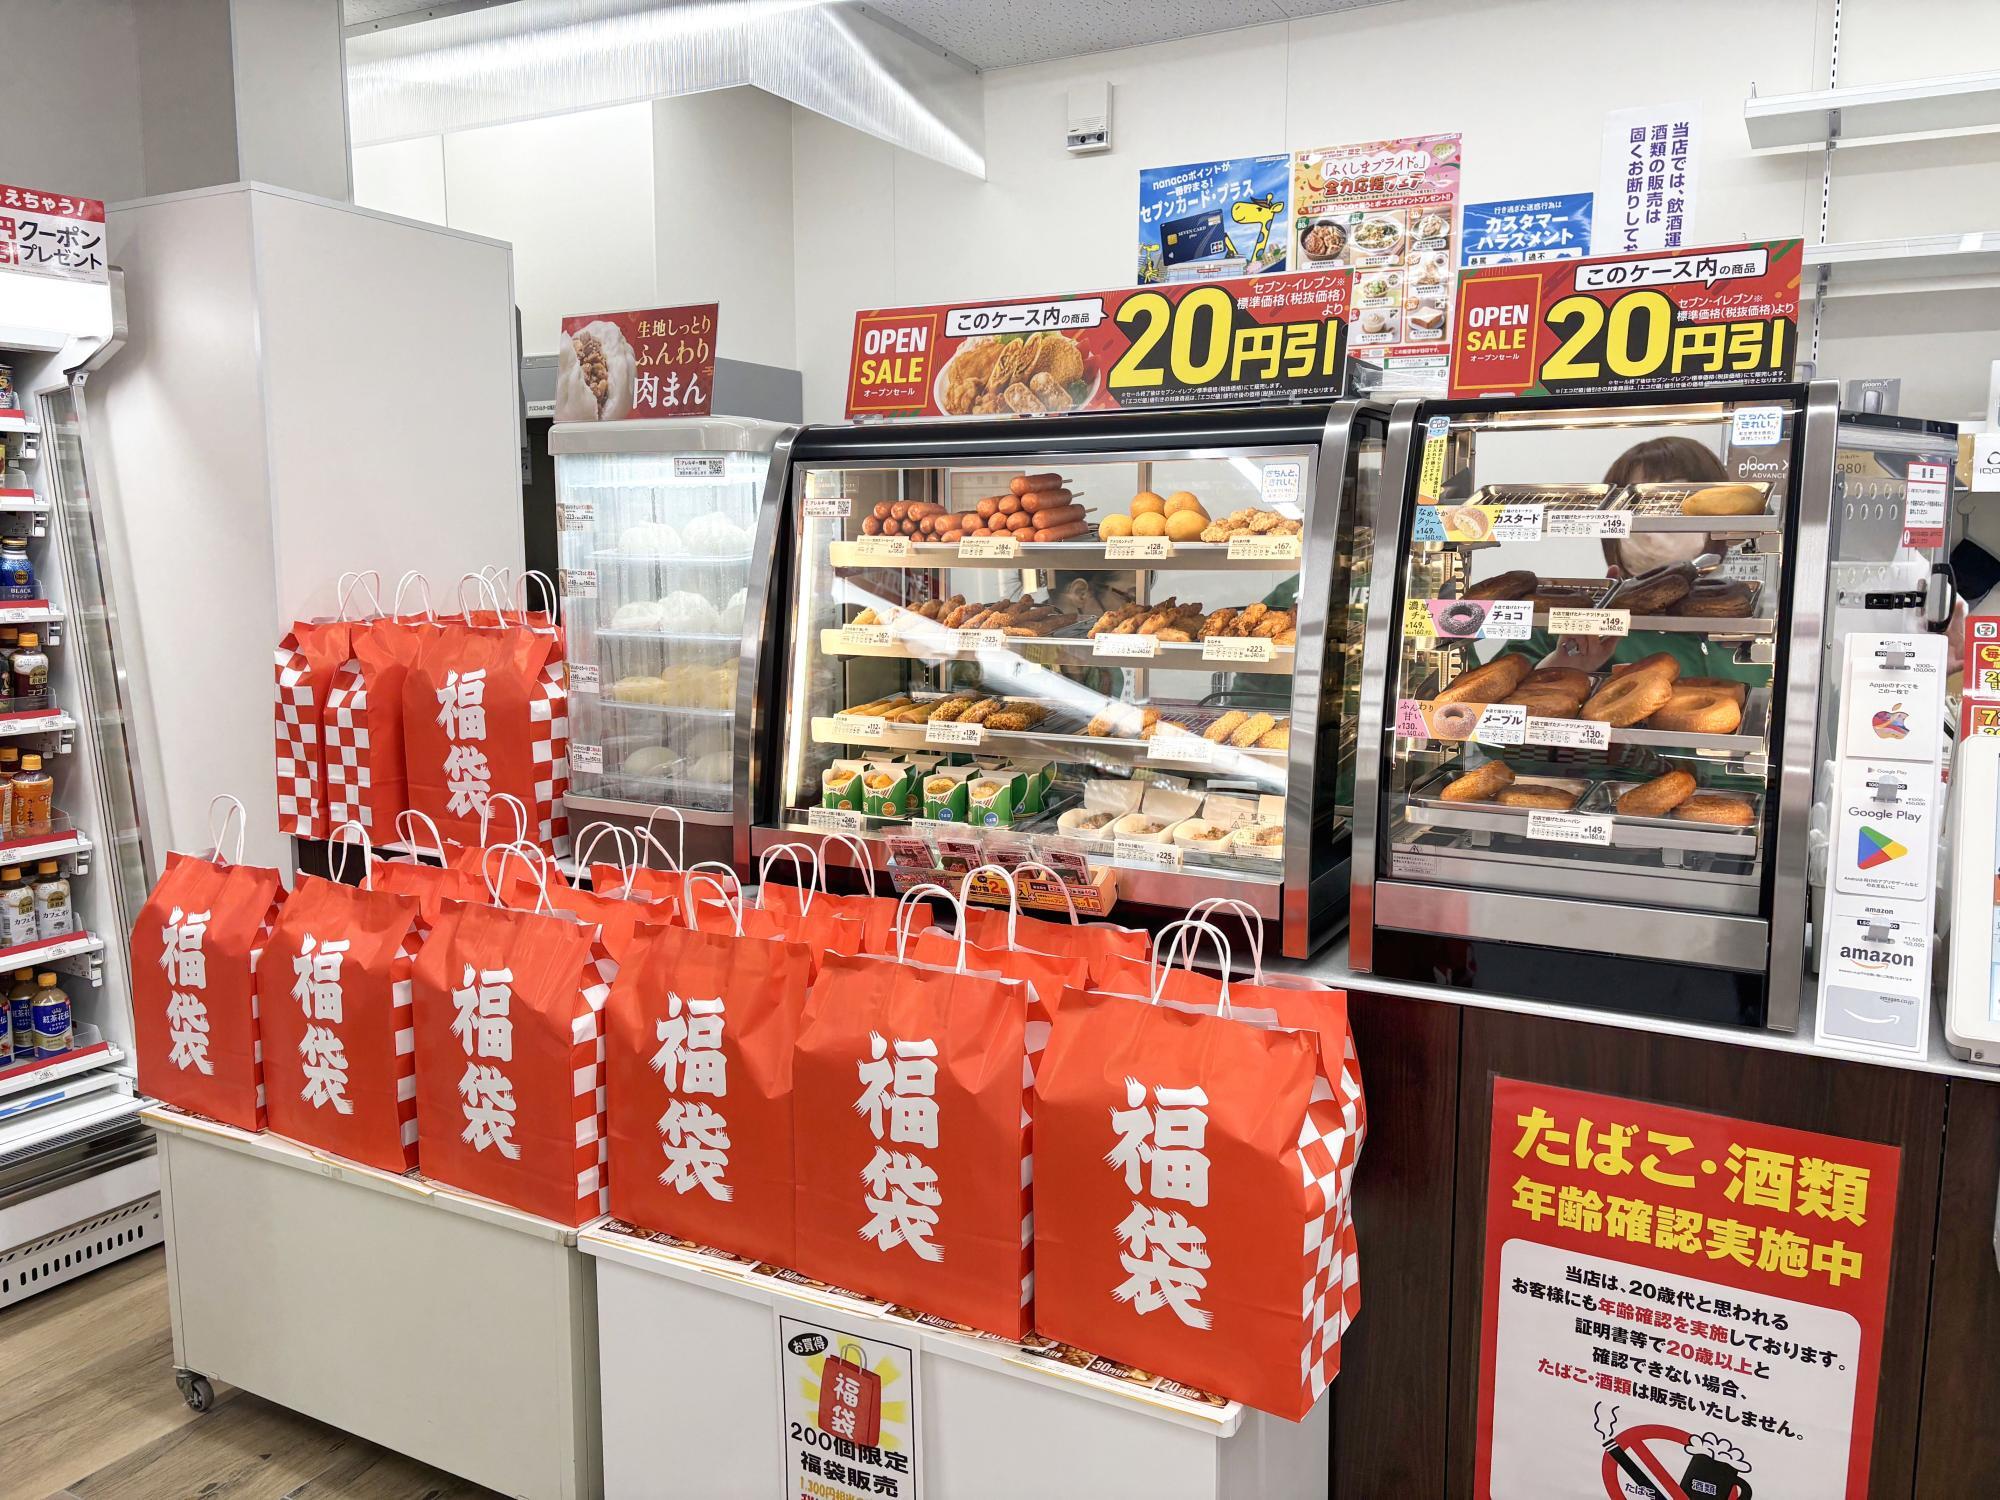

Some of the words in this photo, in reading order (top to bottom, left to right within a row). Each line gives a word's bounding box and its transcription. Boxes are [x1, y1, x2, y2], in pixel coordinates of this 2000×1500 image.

[1153, 161, 1231, 190] nanacoポイントが
[1323, 172, 1426, 196] 全力応援フェア
[1646, 124, 1668, 224] 酒類の販売は
[1665, 122, 1689, 248] 当店では、飲酒運
[0, 188, 86, 217] えちゃう!
[1140, 179, 1255, 224] セブンカード・プラス
[18, 221, 101, 250] クーポン
[1485, 213, 1569, 233] カスタマー
[1477, 228, 1574, 250] ハラスメント
[20, 243, 102, 270] プレゼント
[1587, 257, 1756, 286] このケース内の商品
[1236, 288, 1346, 310] 標準価格(税抜価格)
[1321, 303, 1343, 316] より
[1677, 303, 1794, 322] 標準価格(税抜価格)より
[637, 315, 711, 338] 生地しっとり
[957, 306, 1090, 331] このケース内の商品
[1469, 304, 1529, 328] OPEN
[864, 327, 927, 355] OPEN
[1109, 287, 1338, 388] 20円引
[1466, 328, 1527, 352] SALE
[1541, 291, 1786, 380] 20円引
[635, 338, 709, 367] ふんわり
[1470, 353, 1520, 362] オープンセール
[860, 357, 924, 385] SALE
[632, 371, 706, 410] 肉まん
[863, 388, 915, 398] オープンセール
[1494, 513, 1541, 524] カスタード
[1492, 610, 1523, 620] チョコ
[435, 668, 495, 818] 福袋
[1848, 806, 1893, 821] Google
[1896, 808, 1922, 823] Play
[1864, 906, 1894, 915] amazon
[1840, 946, 1914, 967] amazon
[158, 905, 214, 1075] 福袋
[290, 932, 354, 1115] 福袋
[450, 962, 522, 1160] 福袋
[647, 991, 734, 1202] 福袋
[852, 1030, 945, 1262] 福袋
[1513, 1106, 1870, 1227] たばこ・酒類
[1103, 1075, 1214, 1331] 福袋
[1511, 1175, 1863, 1287] 年齢確認実施中
[1565, 1266, 1790, 1331] 当店は、20歳代と思われる
[1511, 1277, 1846, 1372] お客様にも年齢確認を実施しております。
[792, 1336, 826, 1354] お買得
[1575, 1317, 1771, 1381] 証明書等で20歳以上と
[1592, 1346, 1750, 1400] 確認できない場合、
[832, 1372, 860, 1440] 福袋
[1537, 1357, 1804, 1441] たばこ・酒類は販売いたしません。
[790, 1422, 909, 1474] 200個限定
[801, 1450, 898, 1498] 福袋販売
[1691, 1479, 1717, 1496] 酒類
[1625, 1482, 1656, 1500] たばこ
